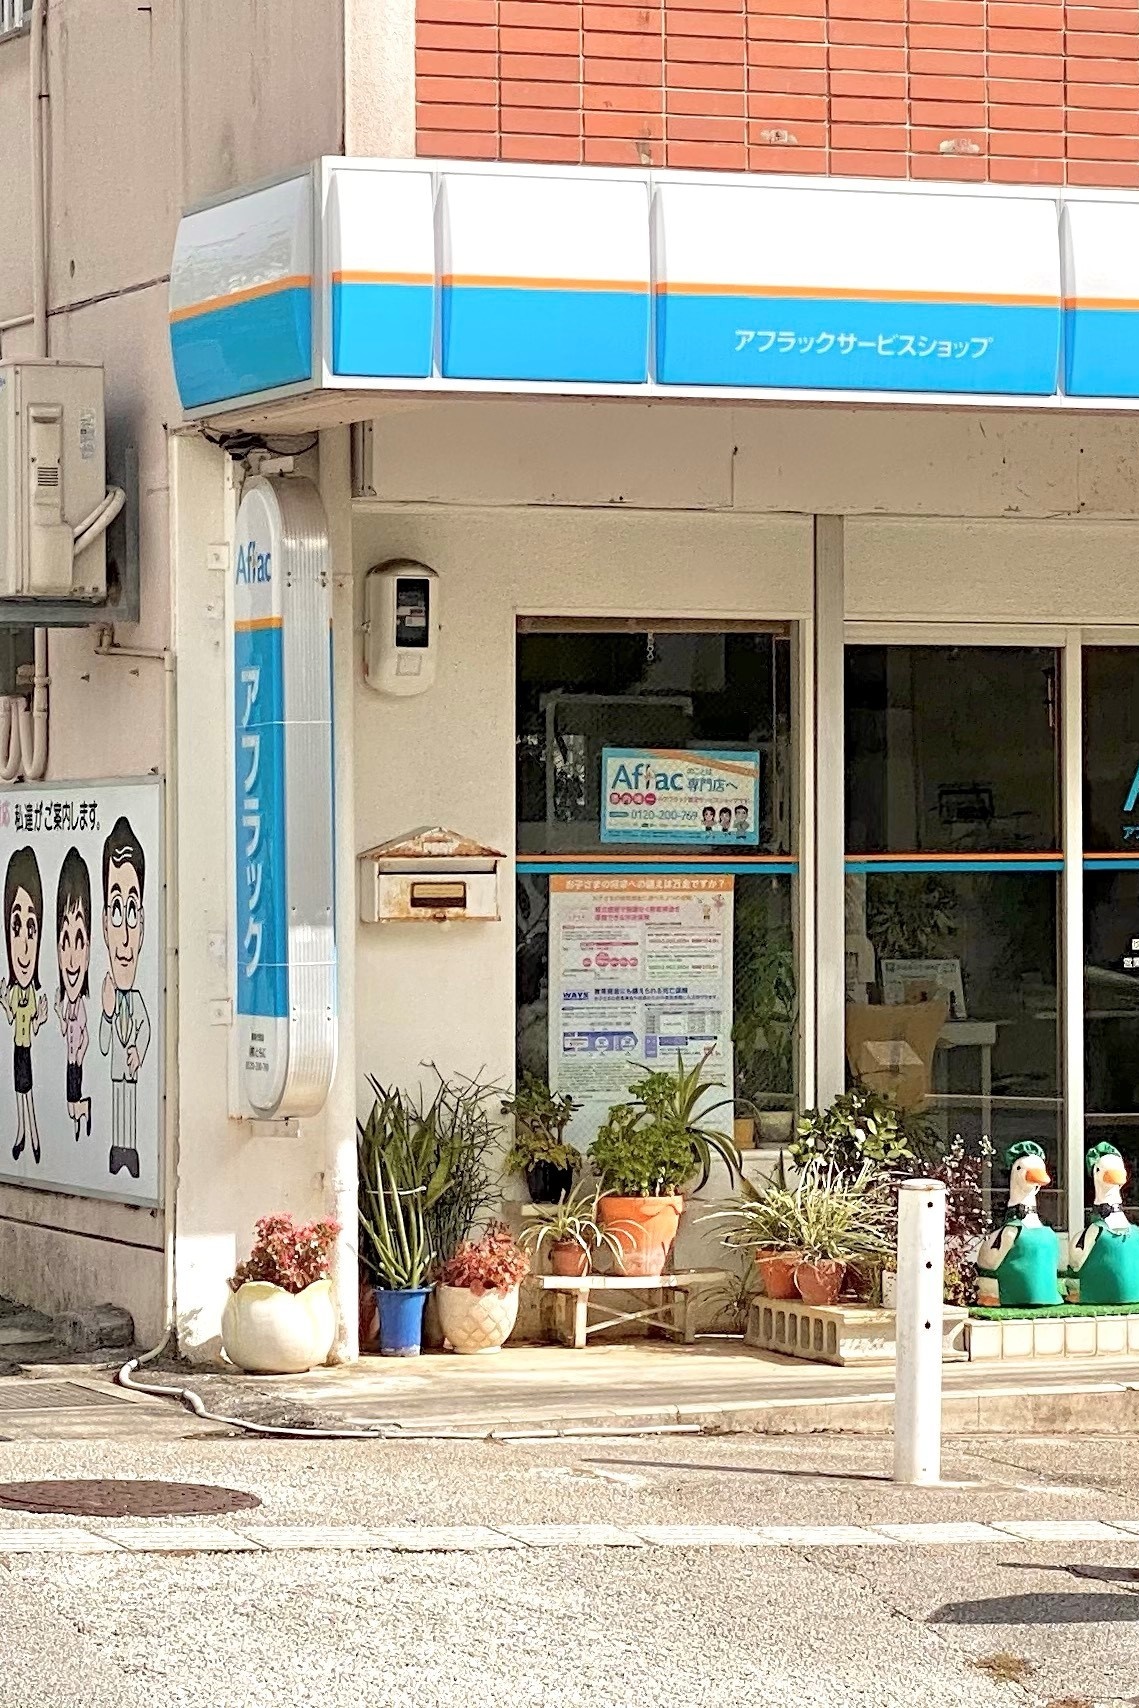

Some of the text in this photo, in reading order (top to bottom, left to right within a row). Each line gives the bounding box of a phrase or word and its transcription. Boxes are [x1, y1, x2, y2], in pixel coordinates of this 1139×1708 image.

[734, 328, 994, 359] アフラックサービスショップ
[240, 665, 263, 979] アフラック
